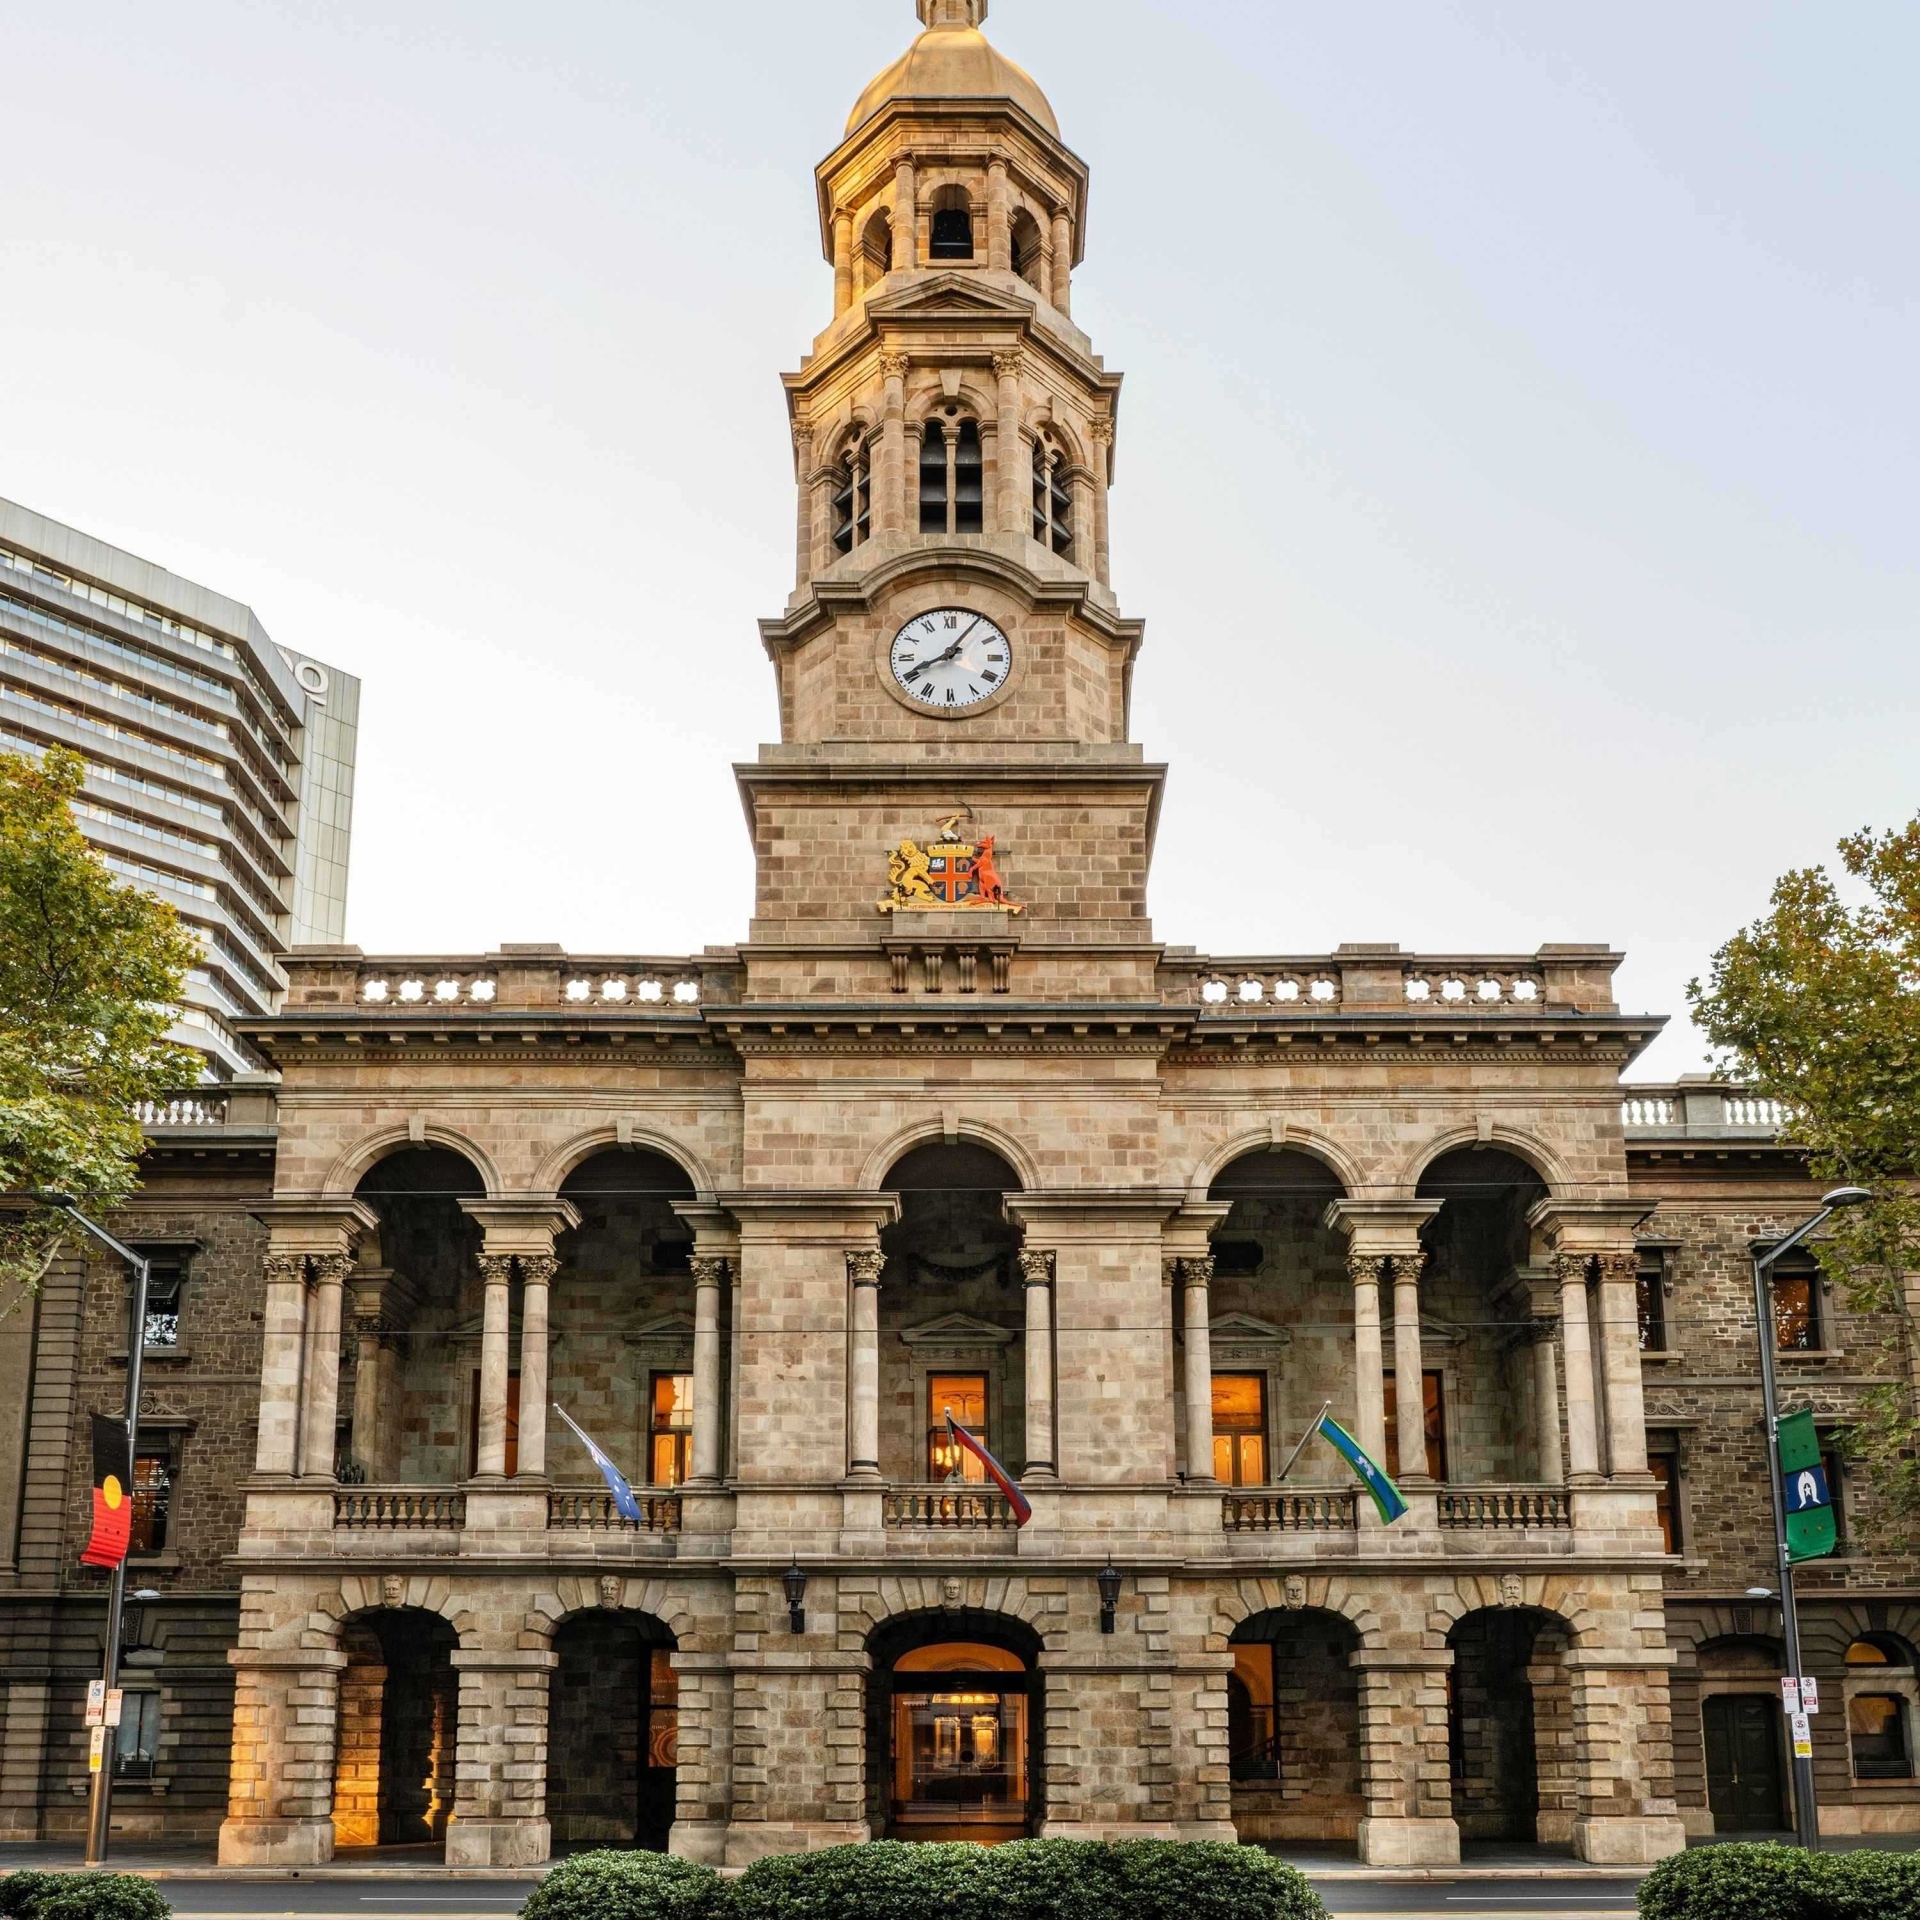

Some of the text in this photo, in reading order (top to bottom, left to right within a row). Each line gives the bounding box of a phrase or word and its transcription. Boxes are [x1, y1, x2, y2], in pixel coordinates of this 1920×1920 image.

[921, 620, 936, 634] XI
[944, 616, 957, 629] XII
[904, 634, 920, 645] X
[898, 653, 914, 662] IX
[946, 688, 955, 702] VI
[968, 683, 980, 696] V
